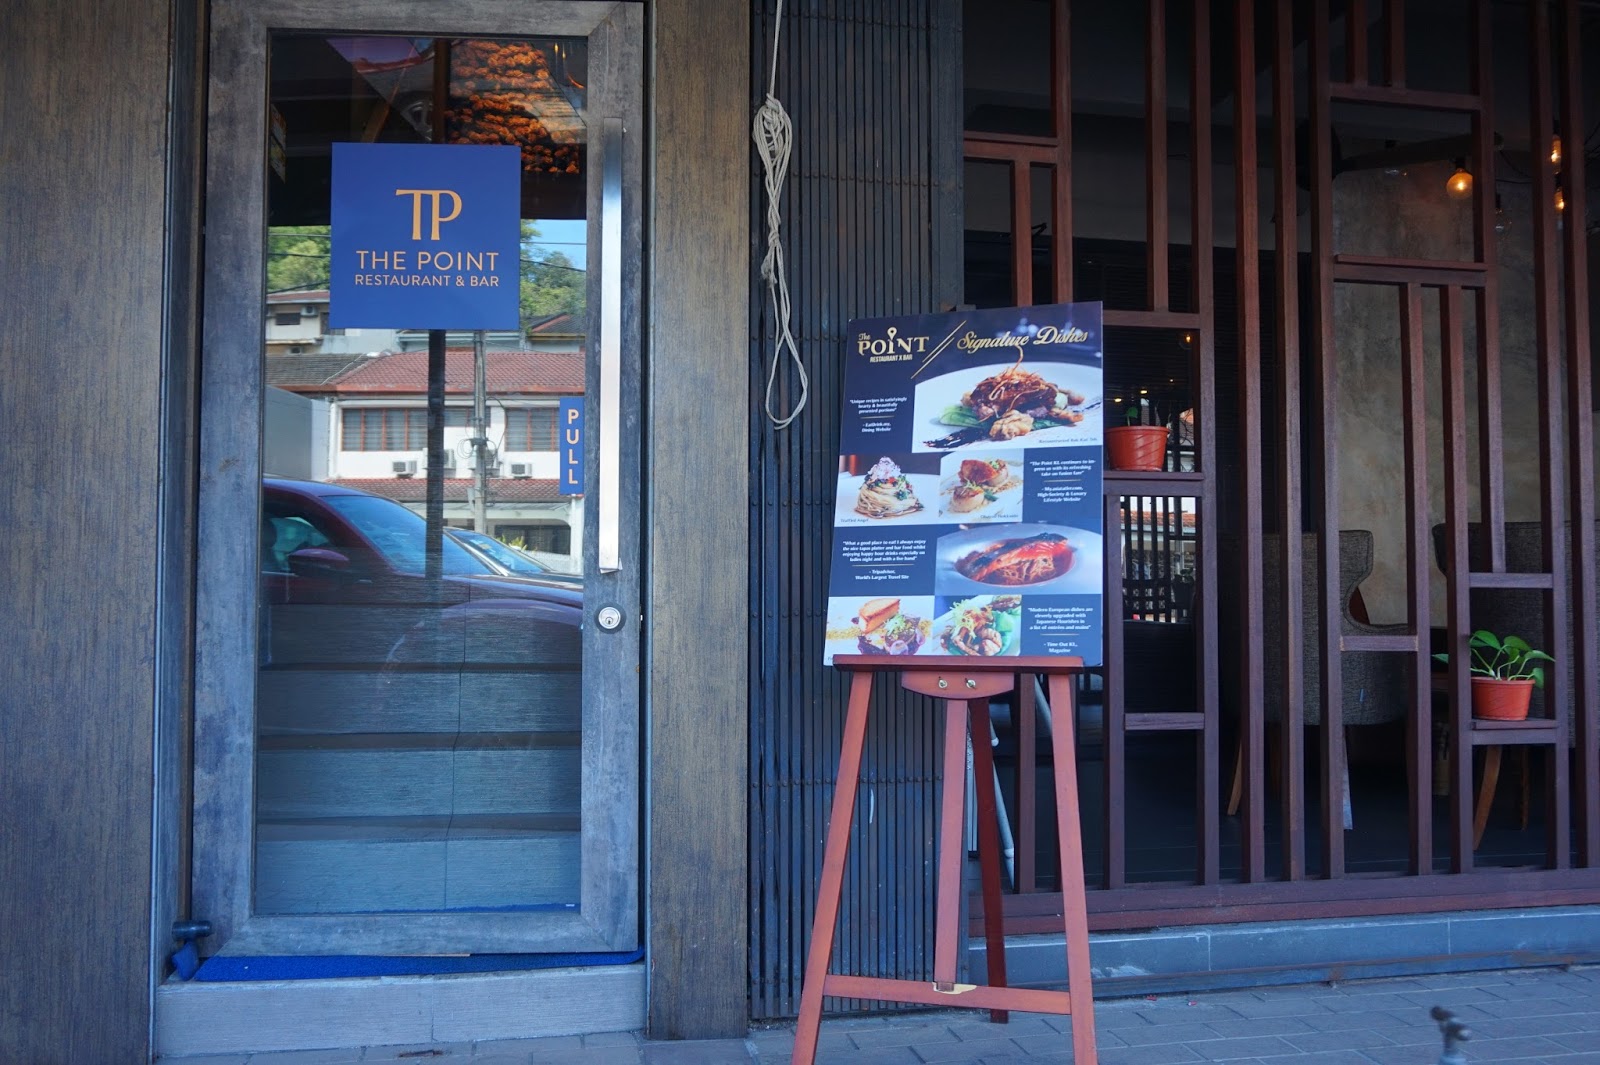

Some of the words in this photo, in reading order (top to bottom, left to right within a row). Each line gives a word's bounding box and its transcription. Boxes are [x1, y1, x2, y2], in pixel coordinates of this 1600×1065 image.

[396, 189, 462, 240] TP
[356, 251, 406, 270] THE
[418, 252, 499, 271] POINT
[355, 274, 451, 286] RESTAURANT
[456, 276, 465, 286] &
[470, 276, 499, 287] BAR
[857, 327, 929, 356] POINT
[957, 331, 1029, 354] Signature
[1033, 326, 1088, 345] Dishes
[566, 409, 579, 484] PULL
